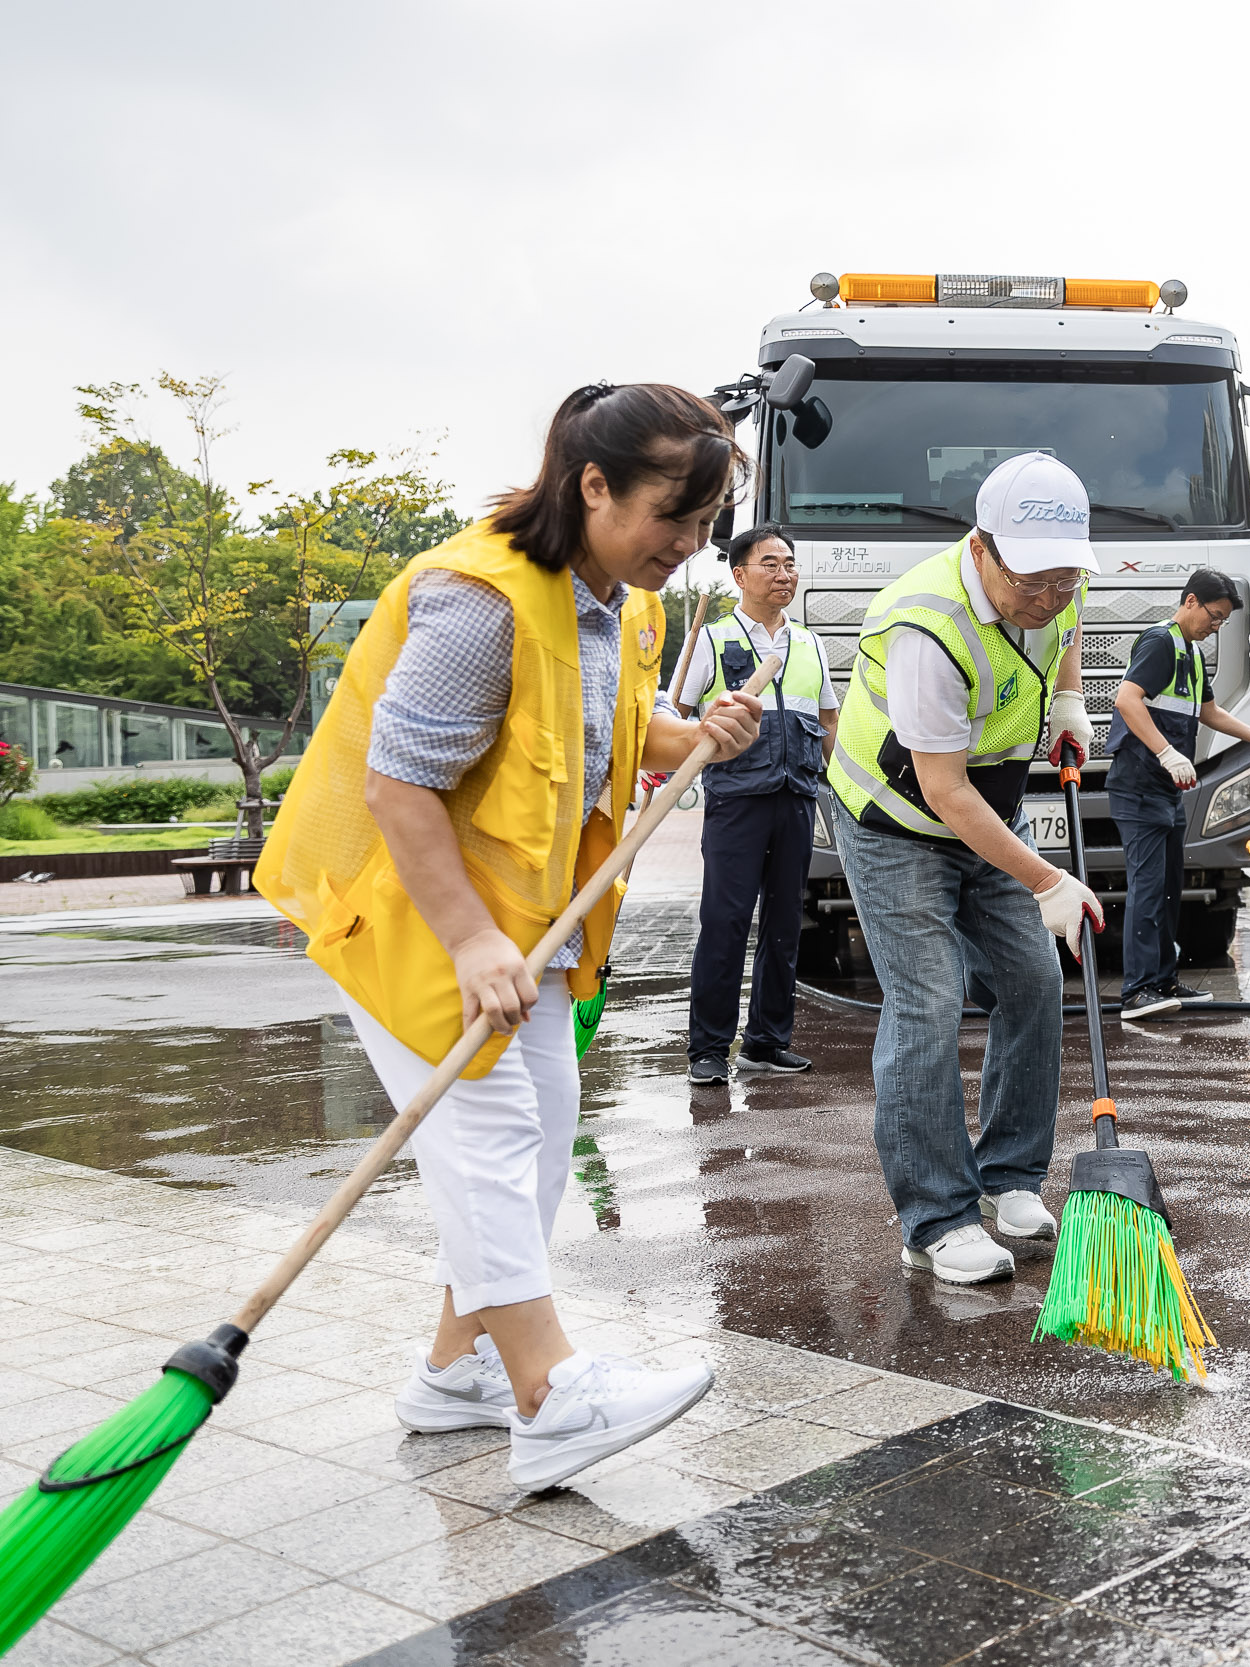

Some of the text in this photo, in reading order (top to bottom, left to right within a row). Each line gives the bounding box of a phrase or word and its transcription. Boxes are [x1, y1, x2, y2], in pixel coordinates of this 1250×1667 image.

[1011, 496, 1089, 524] Titleist
[831, 547, 869, 561] 광진구
[815, 561, 892, 573] HYUNDAI
[1116, 561, 1207, 573] XCIENT
[1029, 816, 1067, 840] 178
